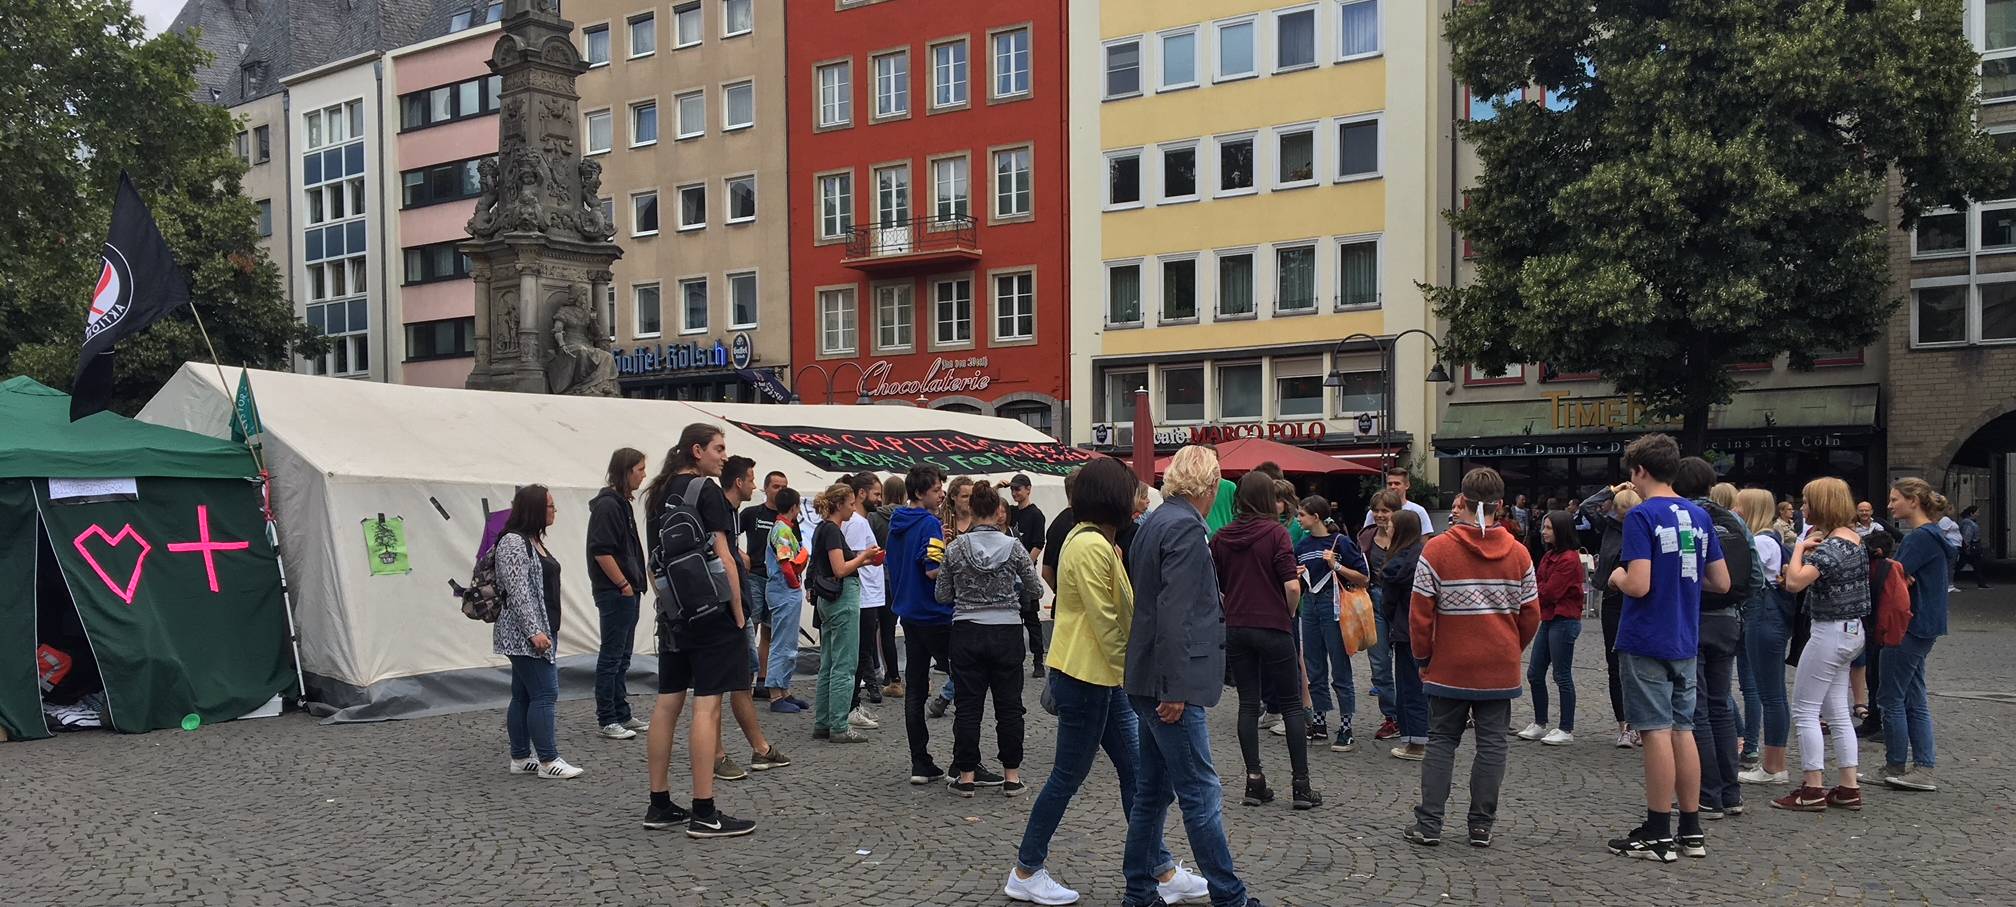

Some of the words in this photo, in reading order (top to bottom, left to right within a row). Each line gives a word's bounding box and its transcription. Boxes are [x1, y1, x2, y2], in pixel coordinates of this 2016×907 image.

[856, 356, 991, 397] Chocolaterie
[1190, 424, 1264, 445] MARCO
[1266, 421, 1326, 441] POLO
[1510, 445, 1527, 455] im
[1535, 443, 1589, 455] Damals
[1727, 438, 1751, 449] ins
[1760, 436, 1792, 448] alte
